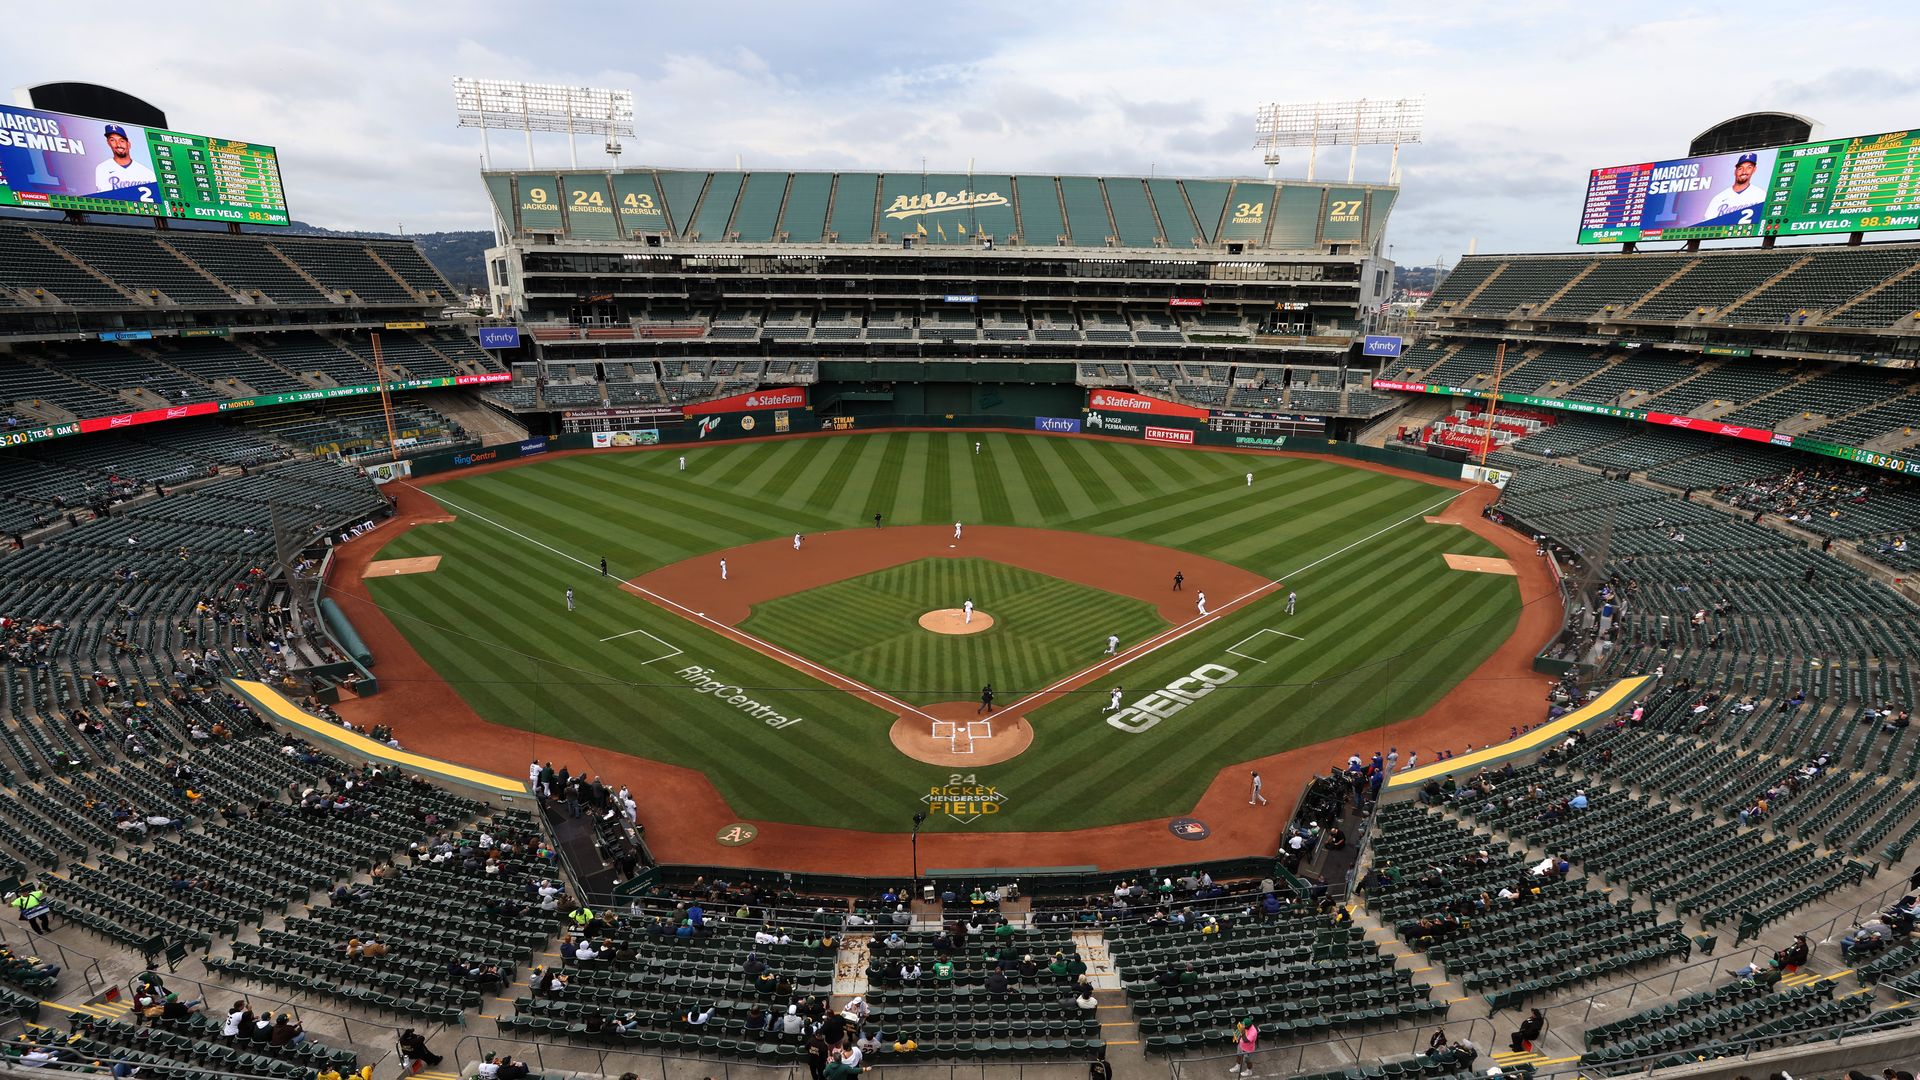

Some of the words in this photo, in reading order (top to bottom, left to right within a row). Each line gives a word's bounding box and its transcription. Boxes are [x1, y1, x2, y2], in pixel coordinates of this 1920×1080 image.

[0, 129, 85, 155] SEMIEN
[1860, 142, 1902, 150] LAUREANO
[1793, 148, 1805, 156] THIS
[1806, 146, 1829, 155] SEASON
[1857, 150, 1888, 158] LOWRIE
[1652, 164, 1700, 181] MARCUS
[1853, 164, 1888, 172] MURPHY
[1648, 176, 1712, 194] SEMIEN
[1849, 176, 1899, 185] BETHANCOURT
[138, 187, 154, 203] 2
[530, 188, 547, 203] 9
[572, 190, 604, 206] 24
[624, 193, 654, 209] 43
[884, 189, 1008, 216] Athletics
[522, 203, 558, 211] JACKSON
[569, 205, 612, 213] HENDERSON
[1235, 203, 1264, 217] 34
[1330, 201, 1361, 215] 27
[194, 208, 215, 217] EXIT
[218, 209, 243, 218] VELO:
[1738, 209, 1754, 224] 2
[1790, 219, 1816, 228] EXIT
[1819, 217, 1851, 226] VELO:
[486, 333, 514, 343] xfinity
[1369, 341, 1396, 352] xfinity
[228, 400, 254, 408] MONTAS
[698, 416, 721, 439] 7UP
[1041, 420, 1073, 432] xfinity
[1105, 423, 1137, 432] PERMANENTE
[33, 430, 46, 438] TEX
[57, 426, 72, 435] OAK
[1148, 430, 1189, 441] CRAFTSMAN
[1445, 431, 1486, 445] Budweiser
[1770, 439, 1792, 447] ATHLETICS
[521, 443, 543, 451] Southwest
[454, 450, 496, 465] RingCentral
[379, 466, 390, 476] 811
[674, 665, 802, 729] RingCentral
[1106, 663, 1239, 734] GEICO
[949, 774, 976, 785] 24
[930, 786, 996, 796] RICKEY
[929, 802, 1000, 815] FIELD
[718, 826, 752, 842] A's
[940, 969, 949, 977] 26
